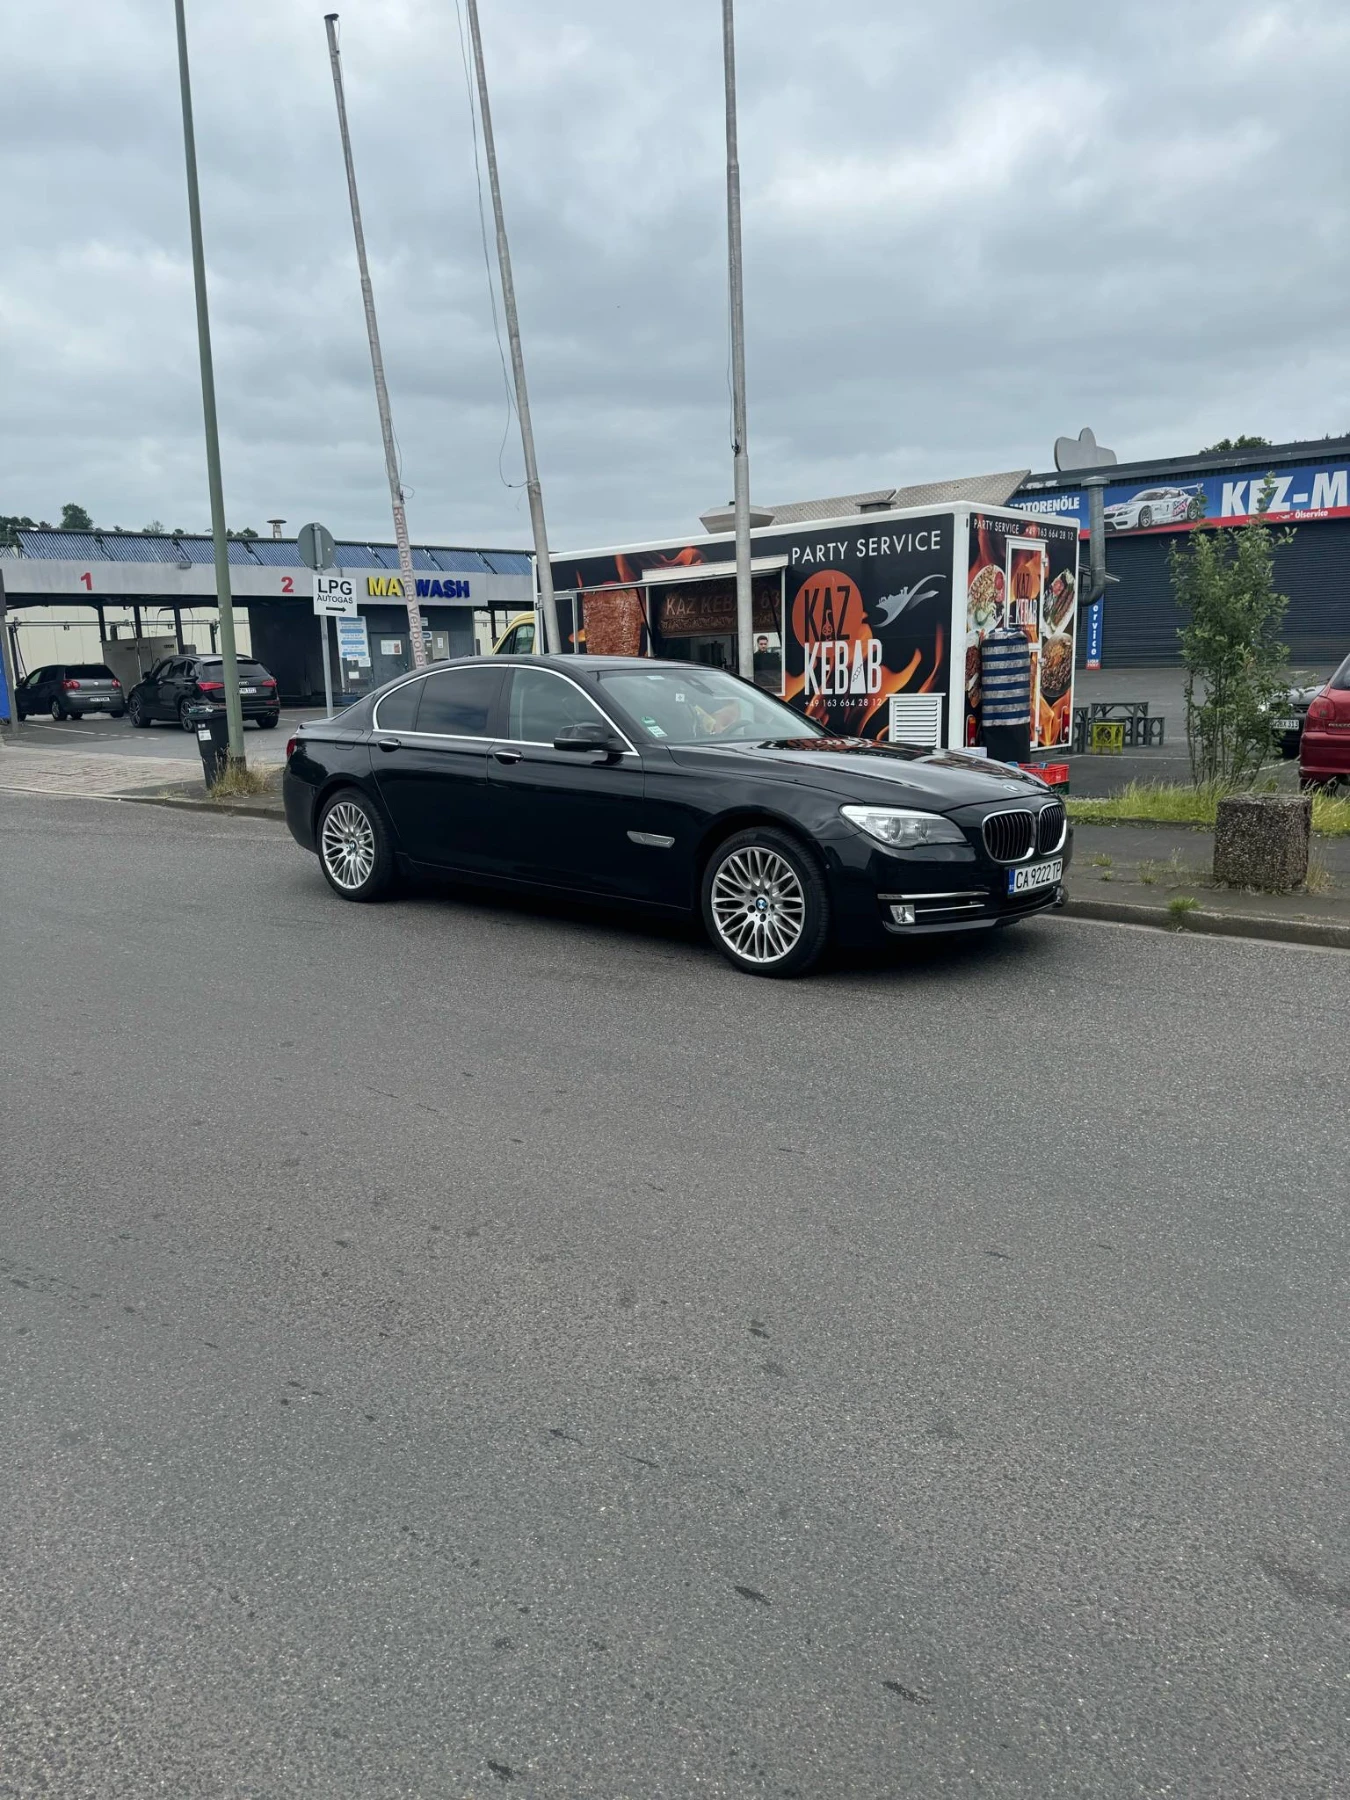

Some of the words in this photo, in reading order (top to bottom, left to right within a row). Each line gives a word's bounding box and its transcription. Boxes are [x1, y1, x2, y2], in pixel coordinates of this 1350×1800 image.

[1295, 509, 1328, 519] Ölservice
[973, 518, 992, 531] PARTY
[994, 521, 1019, 535] SERVICE
[1038, 527, 1047, 537] 163
[1048, 529, 1058, 539] 664
[1067, 531, 1074, 541] 12
[393, 506, 416, 603] Radiobetrieb
[792, 541, 848, 565] PARTY
[856, 530, 941, 558] SERVICE
[80, 572, 92, 591] 1
[281, 576, 294, 593] 2
[318, 578, 353, 596] LPG
[316, 594, 354, 604] AUTOGAS
[666, 597, 696, 616] KAZ
[700, 590, 738, 614] KEB
[804, 585, 851, 642] KAZ
[1090, 604, 1099, 655] ervice
[804, 638, 883, 695] KEBAB
[804, 699, 819, 707] +49
[823, 699, 837, 707] 163
[840, 699, 855, 707] 664
[858, 699, 869, 707] 28
[873, 698, 882, 707] 12
[1016, 870, 1029, 889] CA
[1030, 864, 1051, 886] 9222
[1052, 860, 1062, 880] TP
